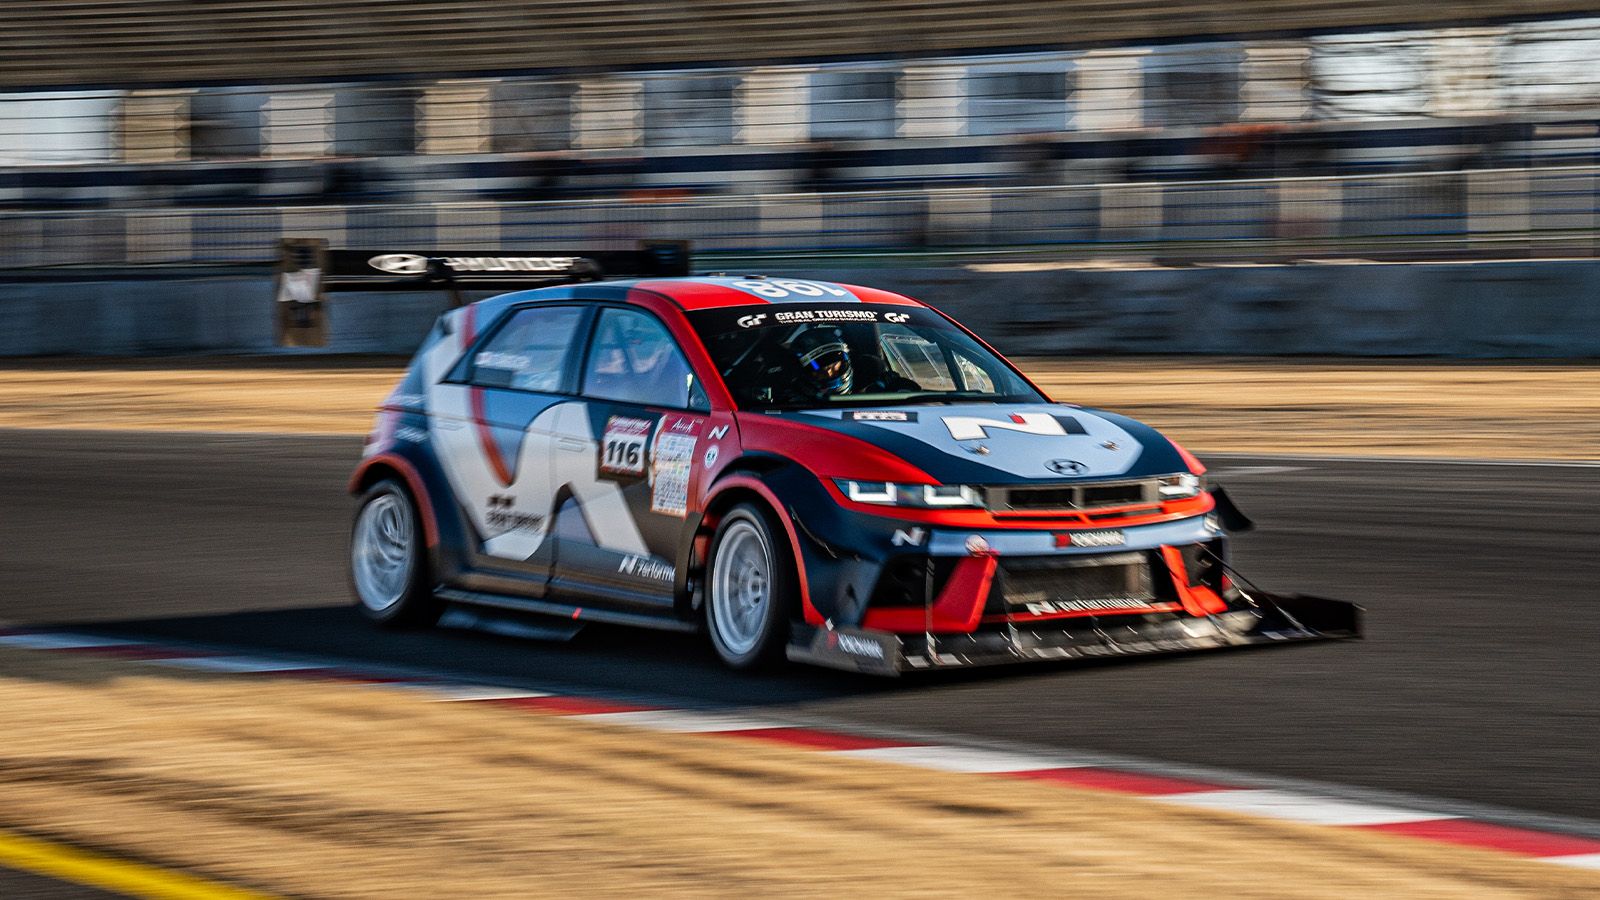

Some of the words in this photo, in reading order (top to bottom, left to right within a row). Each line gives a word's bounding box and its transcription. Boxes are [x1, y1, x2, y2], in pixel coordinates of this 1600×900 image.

[775, 311, 815, 321] GRAN
[707, 424, 730, 440] N
[607, 441, 642, 466] 116
[891, 526, 925, 547] N
[617, 554, 639, 575] N
